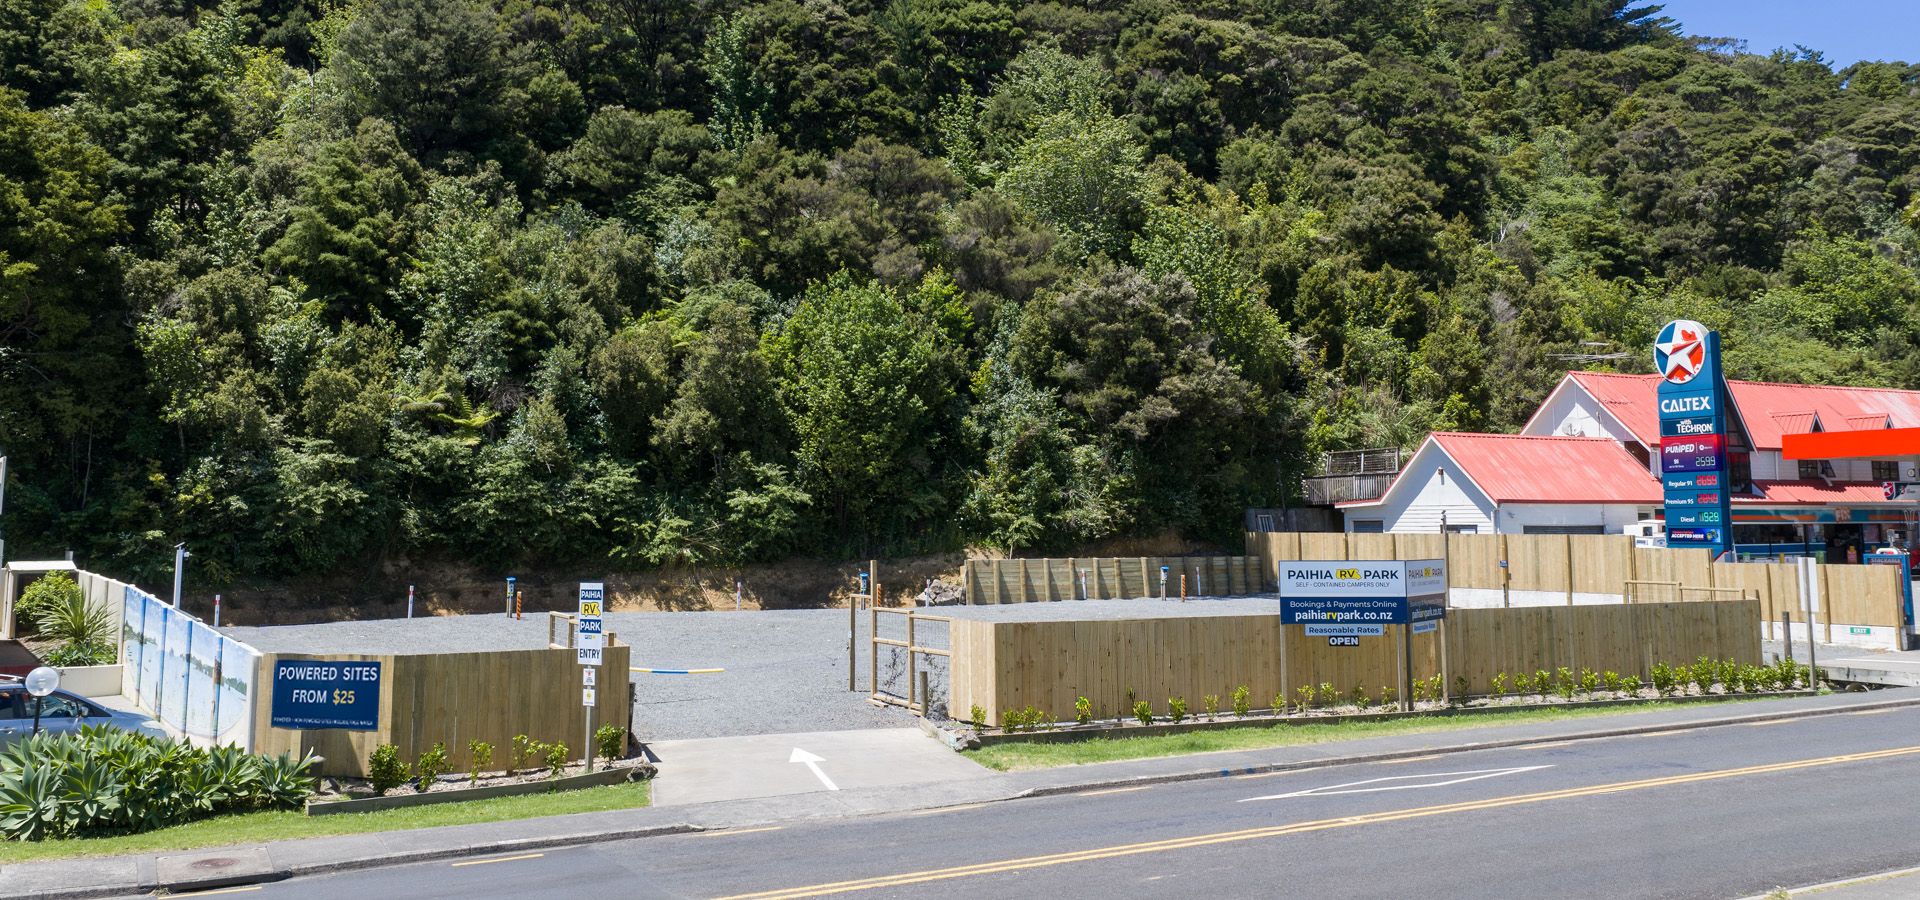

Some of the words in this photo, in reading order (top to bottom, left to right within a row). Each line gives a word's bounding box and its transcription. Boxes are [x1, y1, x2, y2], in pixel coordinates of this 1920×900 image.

[1661, 396, 1711, 413] CALTEX
[1676, 424, 1713, 434] TECHRON
[1665, 444, 1695, 454] PUMPED
[1696, 456, 1716, 466] 2599
[1287, 570, 1333, 580] PAIHIA
[1339, 569, 1355, 579] RV
[1363, 570, 1399, 580] PARK
[581, 591, 601, 599] PAIHIA
[584, 604, 596, 614] RV
[1295, 610, 1393, 622] paihiarvpark.co.nz
[580, 622, 600, 631] PARK
[1329, 637, 1359, 645] OPEN
[579, 649, 600, 659] ENTRY
[278, 667, 338, 680] POWERED
[342, 667, 378, 681] SITES
[292, 690, 327, 704] FROM
[333, 688, 355, 706] $25
